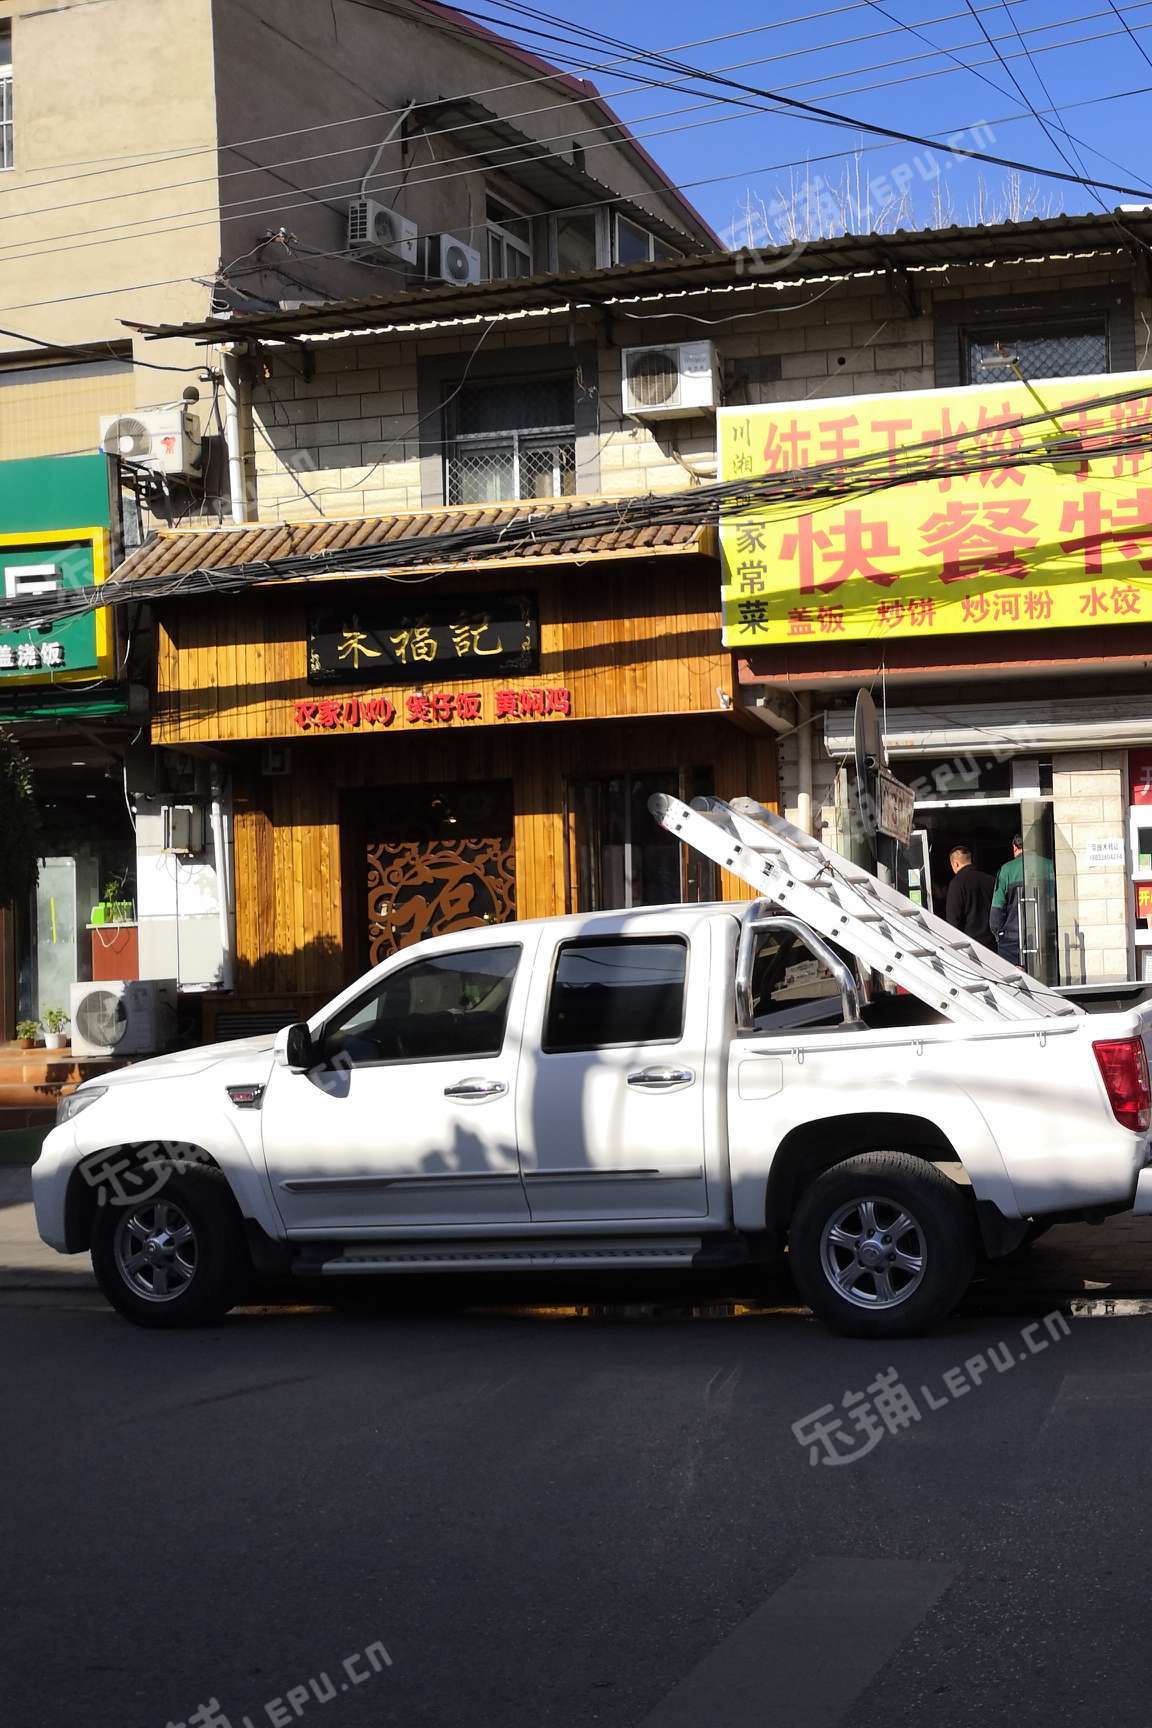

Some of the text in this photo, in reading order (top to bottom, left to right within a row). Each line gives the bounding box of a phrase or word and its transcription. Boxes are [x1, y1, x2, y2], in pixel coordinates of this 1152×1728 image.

[763, 402, 1026, 494] 纯手工水饺
[787, 604, 846, 636] 盖饭
[876, 596, 937, 628] 炒饼
[961, 589, 1054, 624] 炒河粉
[1079, 584, 1141, 617] 水饺
[293, 697, 397, 730] 农家小炒
[494, 687, 572, 718] 黄焖鸡
